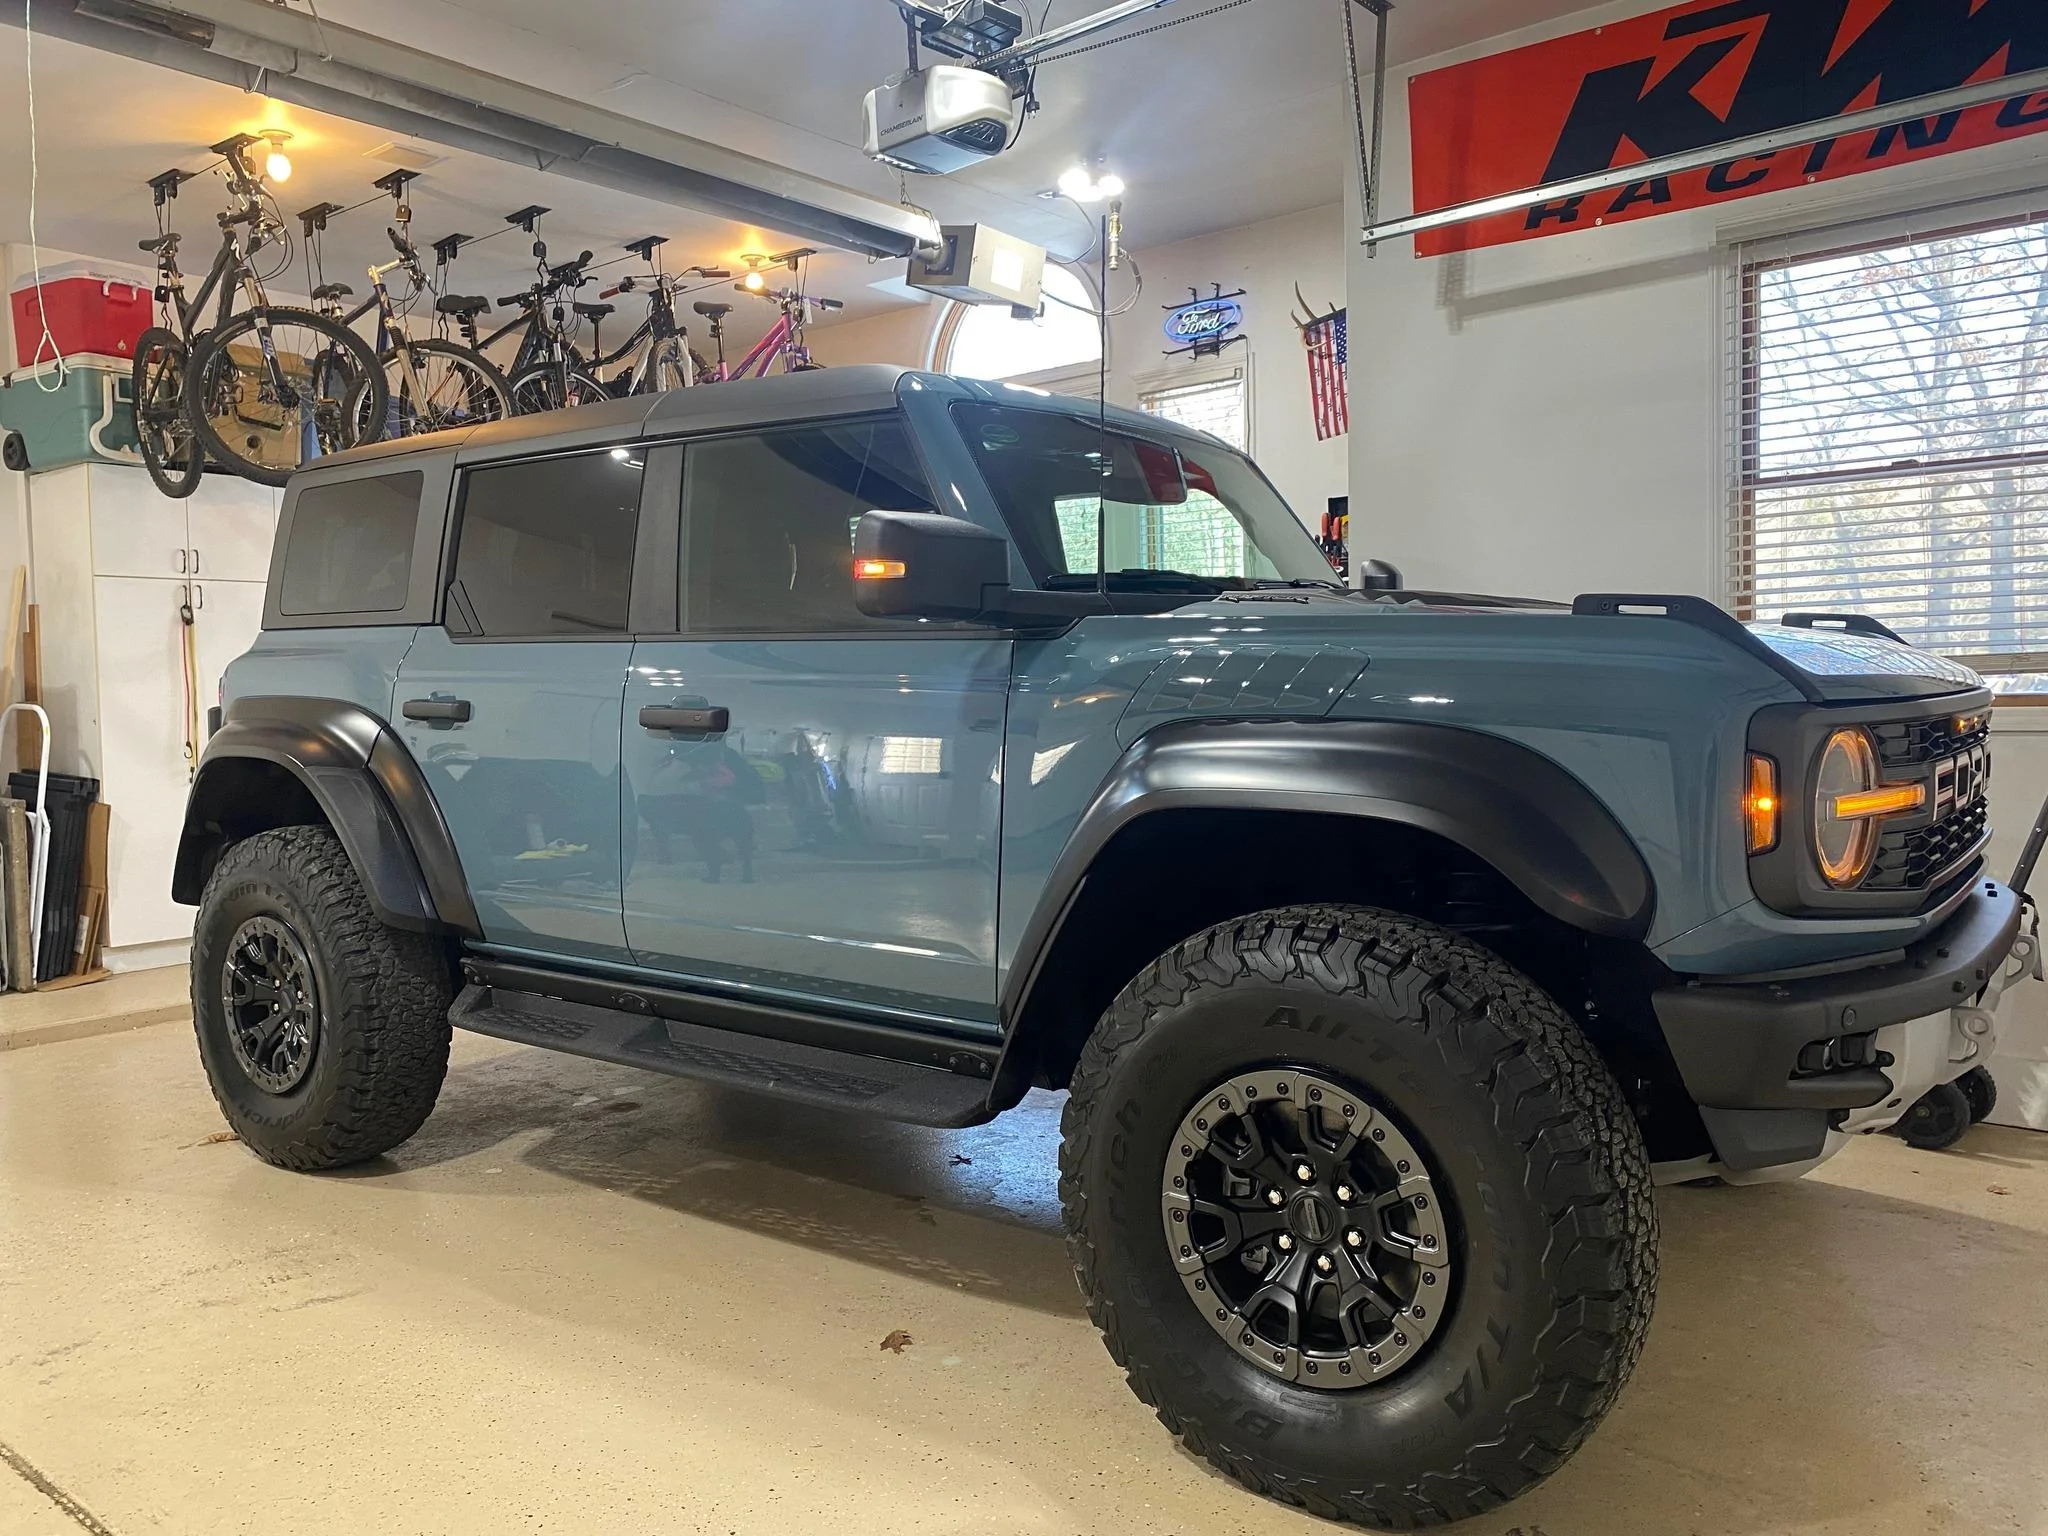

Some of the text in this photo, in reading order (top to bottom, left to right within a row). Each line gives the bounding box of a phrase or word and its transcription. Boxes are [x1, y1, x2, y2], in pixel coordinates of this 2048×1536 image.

[880, 114, 924, 137] CHAMBERLAIN
[1177, 308, 1221, 335] Ford
[1262, 1004, 1512, 1292] All-Terain
